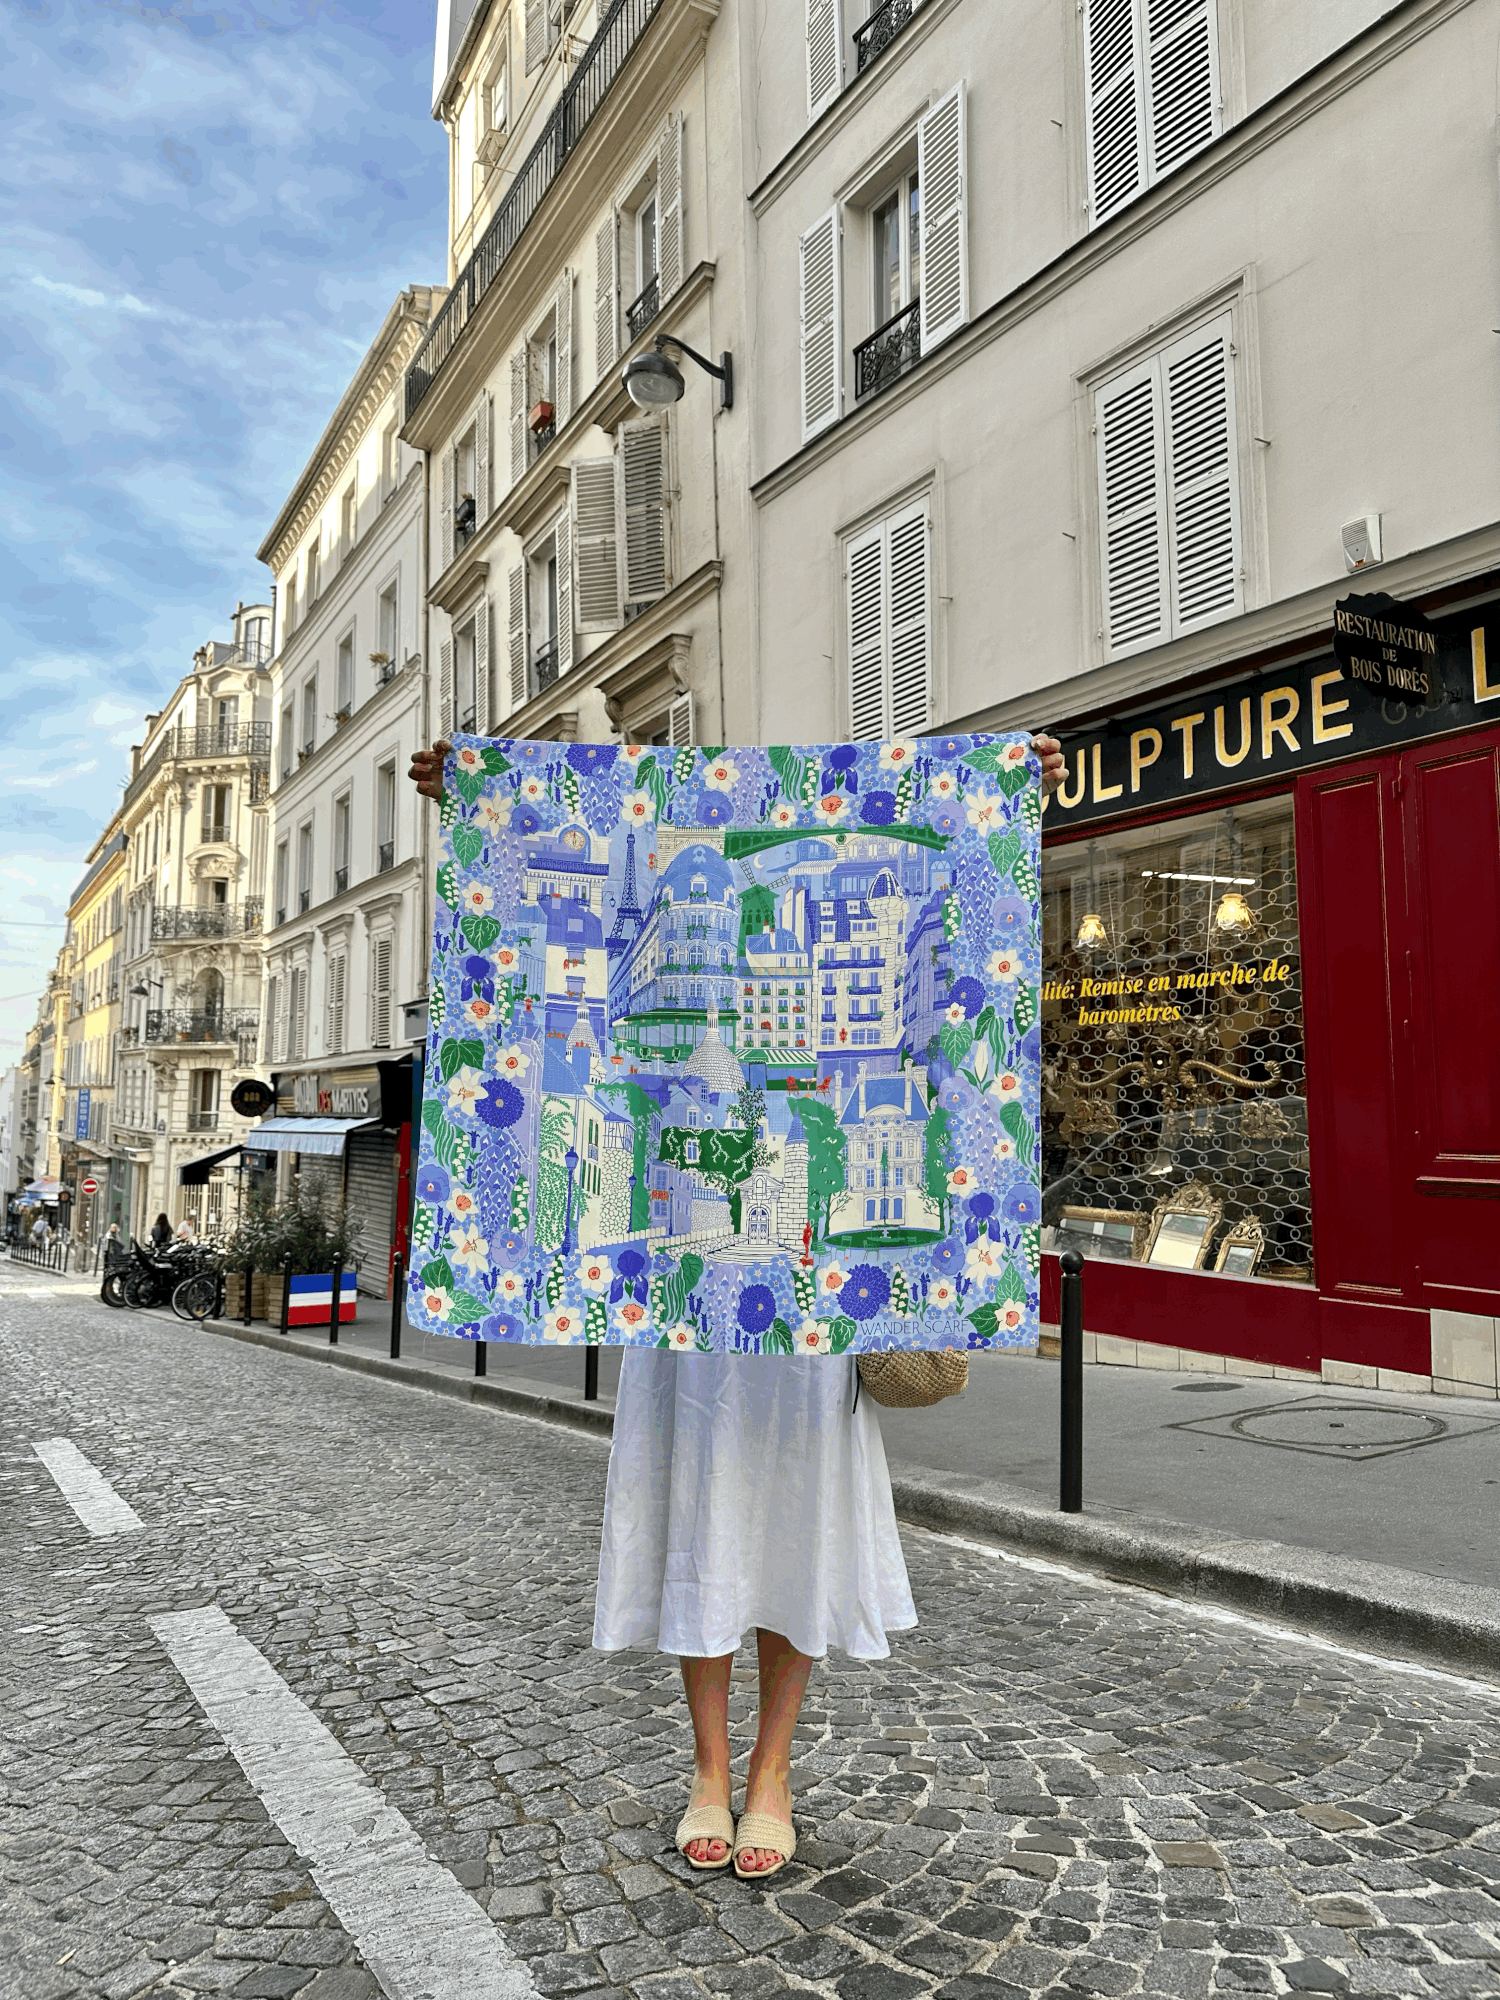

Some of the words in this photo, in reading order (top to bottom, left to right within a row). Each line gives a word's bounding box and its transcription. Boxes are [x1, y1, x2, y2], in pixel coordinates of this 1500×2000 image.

[1336, 609, 1436, 655] RESTAURATION
[1382, 647, 1398, 662] DE
[1350, 656, 1382, 684] BOIS
[1387, 665, 1429, 695] DORÉS
[1042, 669, 1354, 814] ULPTURE
[1080, 974, 1143, 998] Remise
[1148, 976, 1171, 992] en
[1176, 963, 1256, 990] marche
[1262, 958, 1290, 983] de
[1078, 1002, 1182, 1026] baromètres
[331, 1087, 369, 1113] MARTYRS
[860, 1320, 920, 1336] WANDER
[924, 1319, 969, 1334] SCARF
